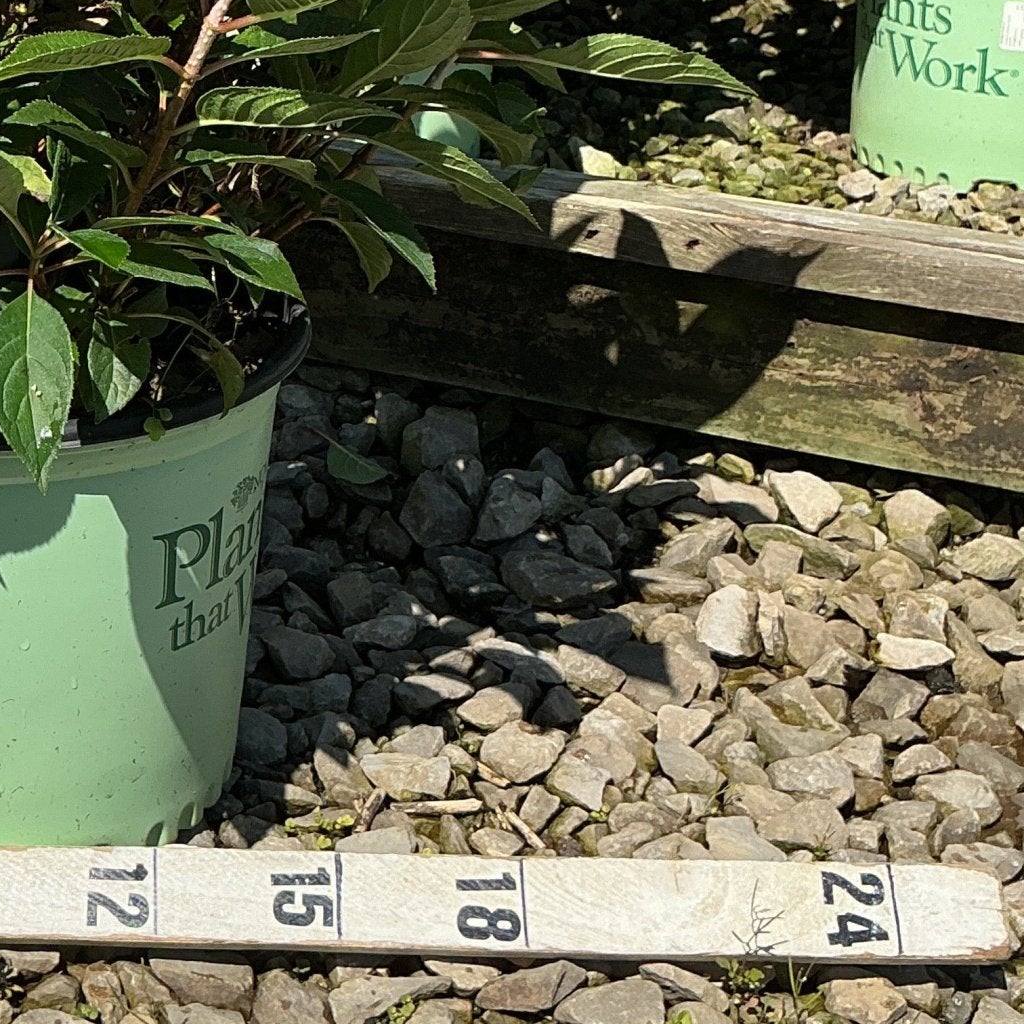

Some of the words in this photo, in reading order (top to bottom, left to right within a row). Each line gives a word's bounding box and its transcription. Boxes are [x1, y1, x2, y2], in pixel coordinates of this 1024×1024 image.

[168, 589, 234, 652] that
[86, 862, 150, 929] 12
[270, 866, 334, 927] 15
[455, 871, 522, 942] 18
[820, 869, 890, 948] 24
